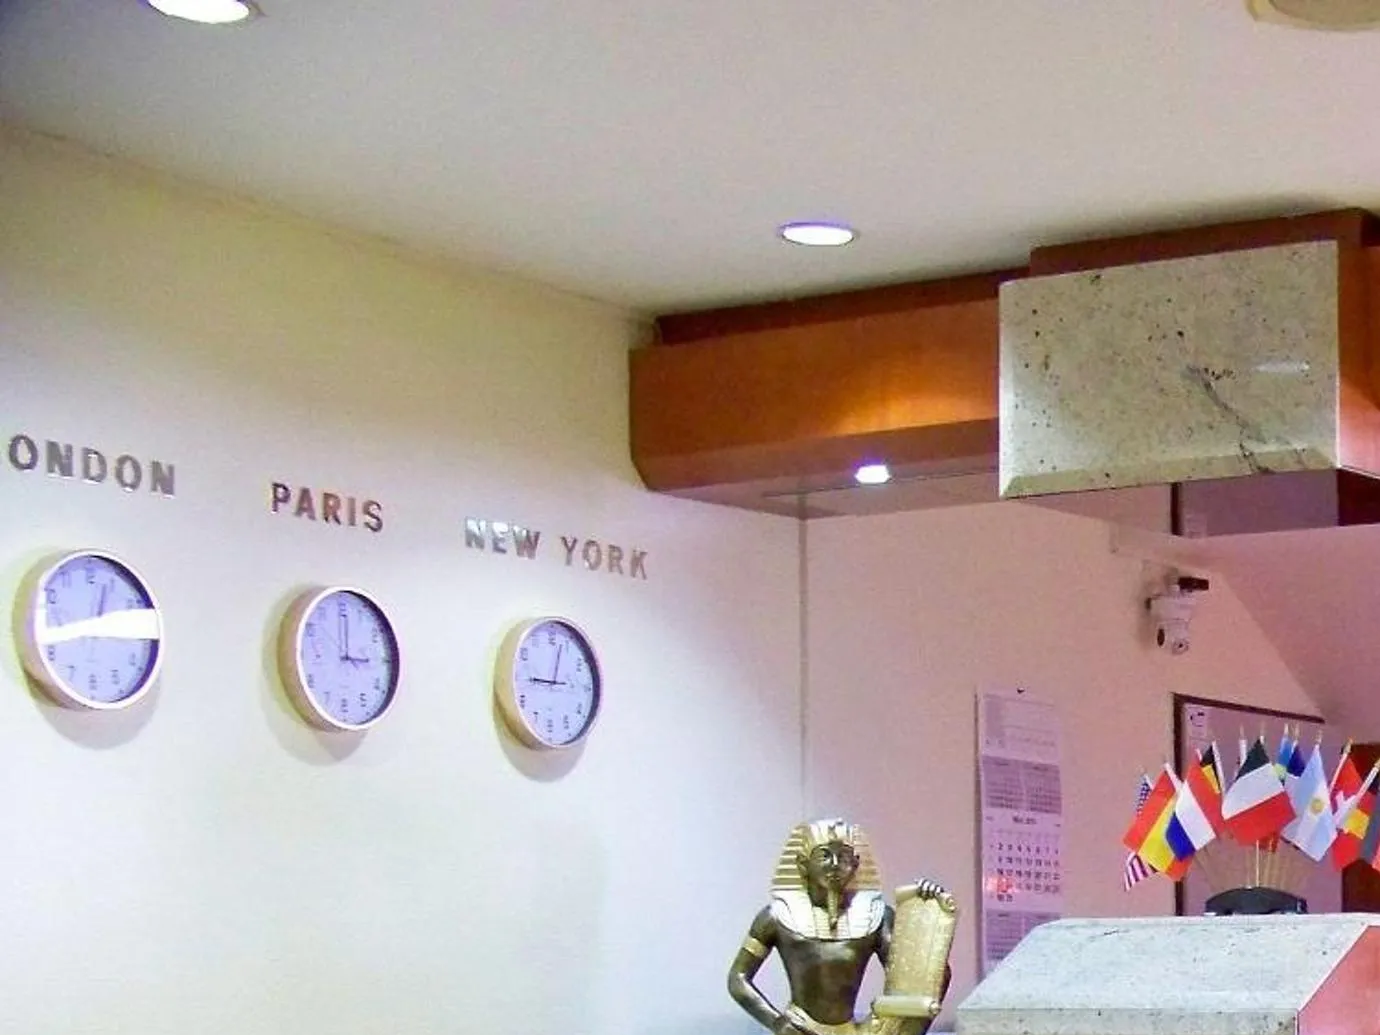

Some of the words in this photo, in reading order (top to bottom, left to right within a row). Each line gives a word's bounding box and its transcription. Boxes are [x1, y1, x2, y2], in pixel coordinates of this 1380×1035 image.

[8, 434, 175, 498] ONDON
[271, 482, 384, 533] PARIS
[464, 517, 542, 560] NEW
[559, 535, 650, 581] YORK
